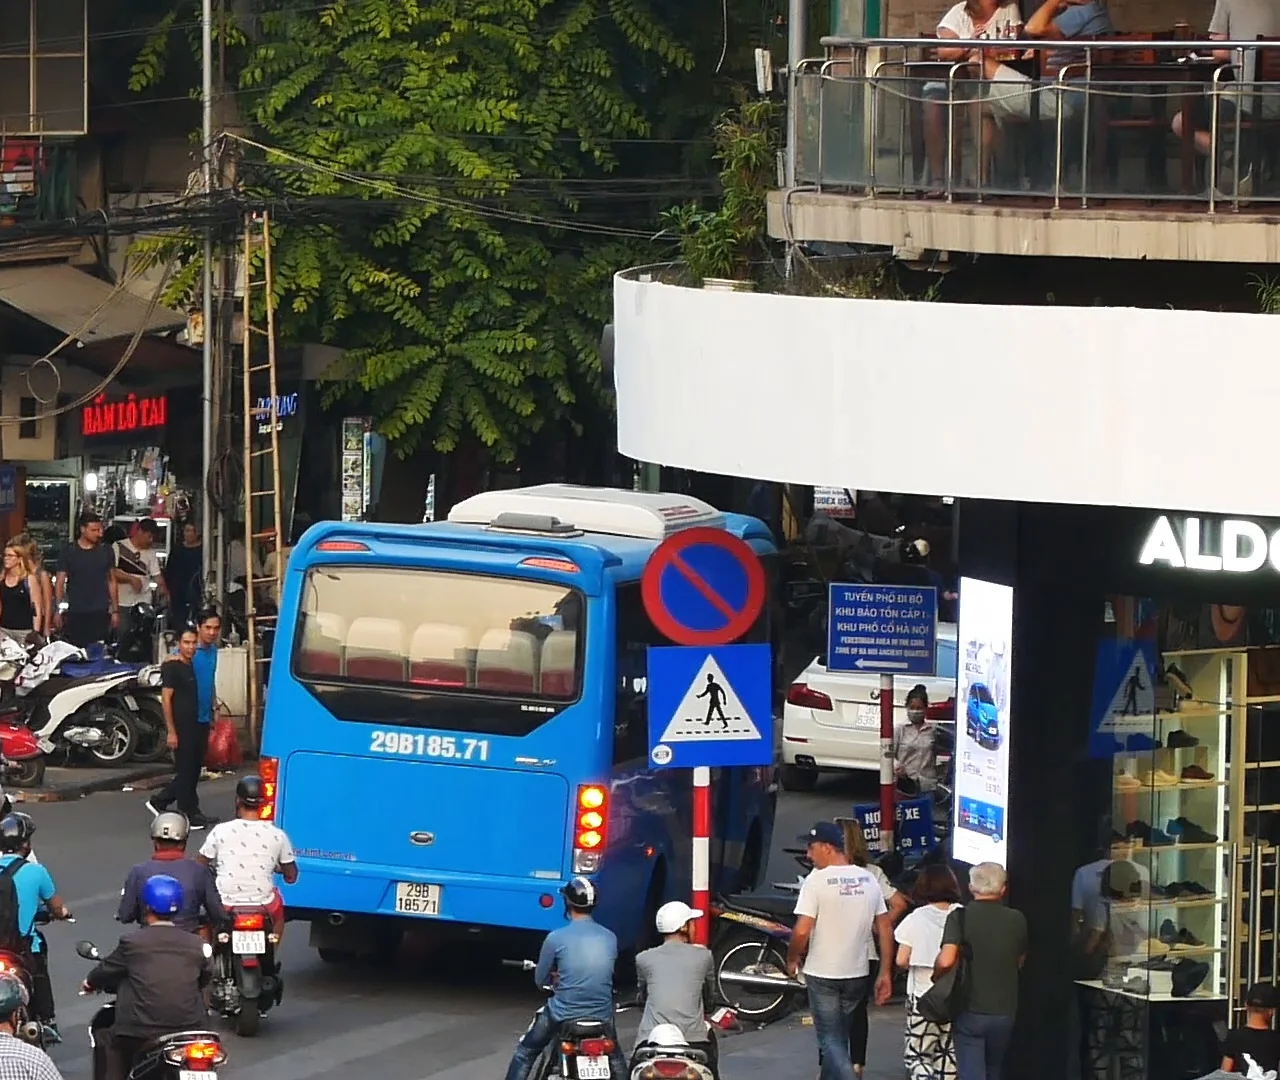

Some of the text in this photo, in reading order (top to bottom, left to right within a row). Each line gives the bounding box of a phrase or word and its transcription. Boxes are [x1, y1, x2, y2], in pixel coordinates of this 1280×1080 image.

[141, 396, 167, 427] TAI
[1138, 514, 1280, 573] ALD
[875, 591, 896, 604] PHỐ
[835, 607, 855, 617] KHU
[837, 622, 857, 632] KHU
[370, 730, 489, 761] 29B185.71
[905, 808, 920, 820] XE
[407, 883, 430, 898] 29B
